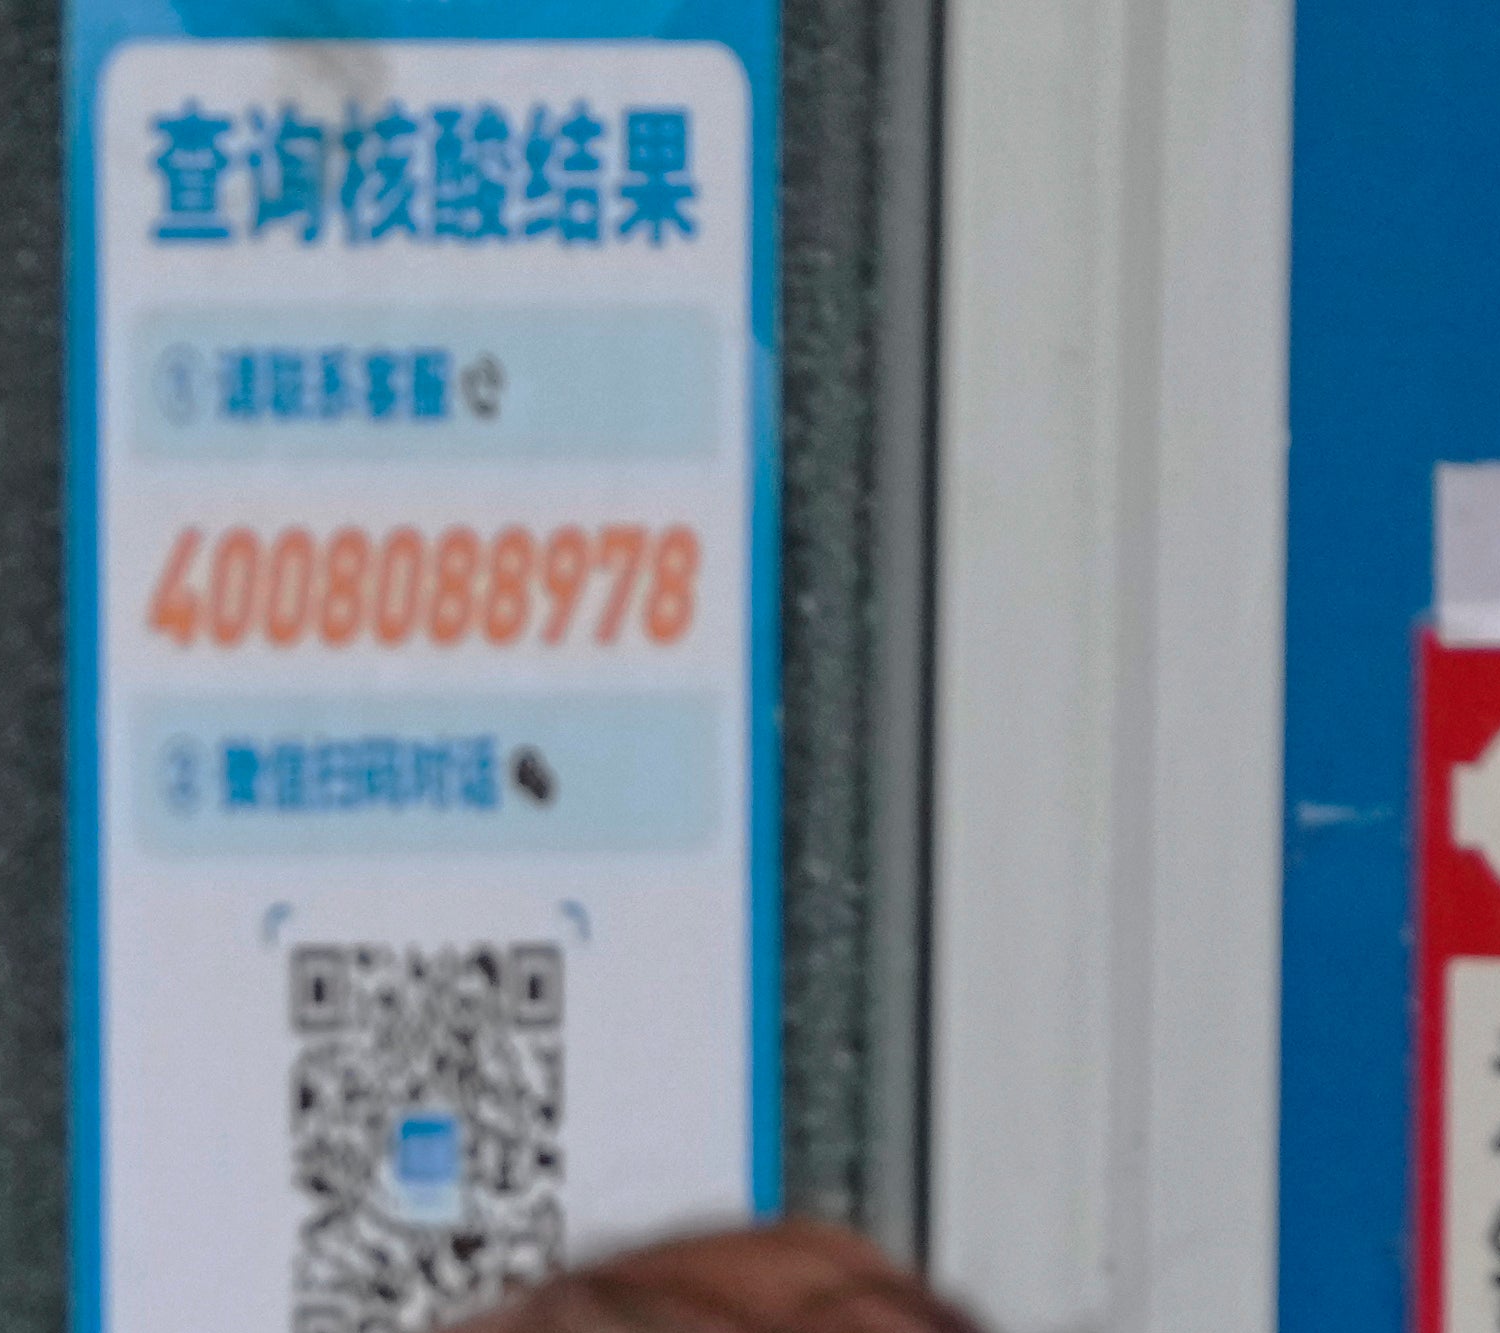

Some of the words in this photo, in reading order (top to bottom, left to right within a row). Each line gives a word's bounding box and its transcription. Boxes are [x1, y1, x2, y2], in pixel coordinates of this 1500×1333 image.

[149, 101, 699, 248] 查询核酸结果
[147, 523, 702, 650] 4008088978
